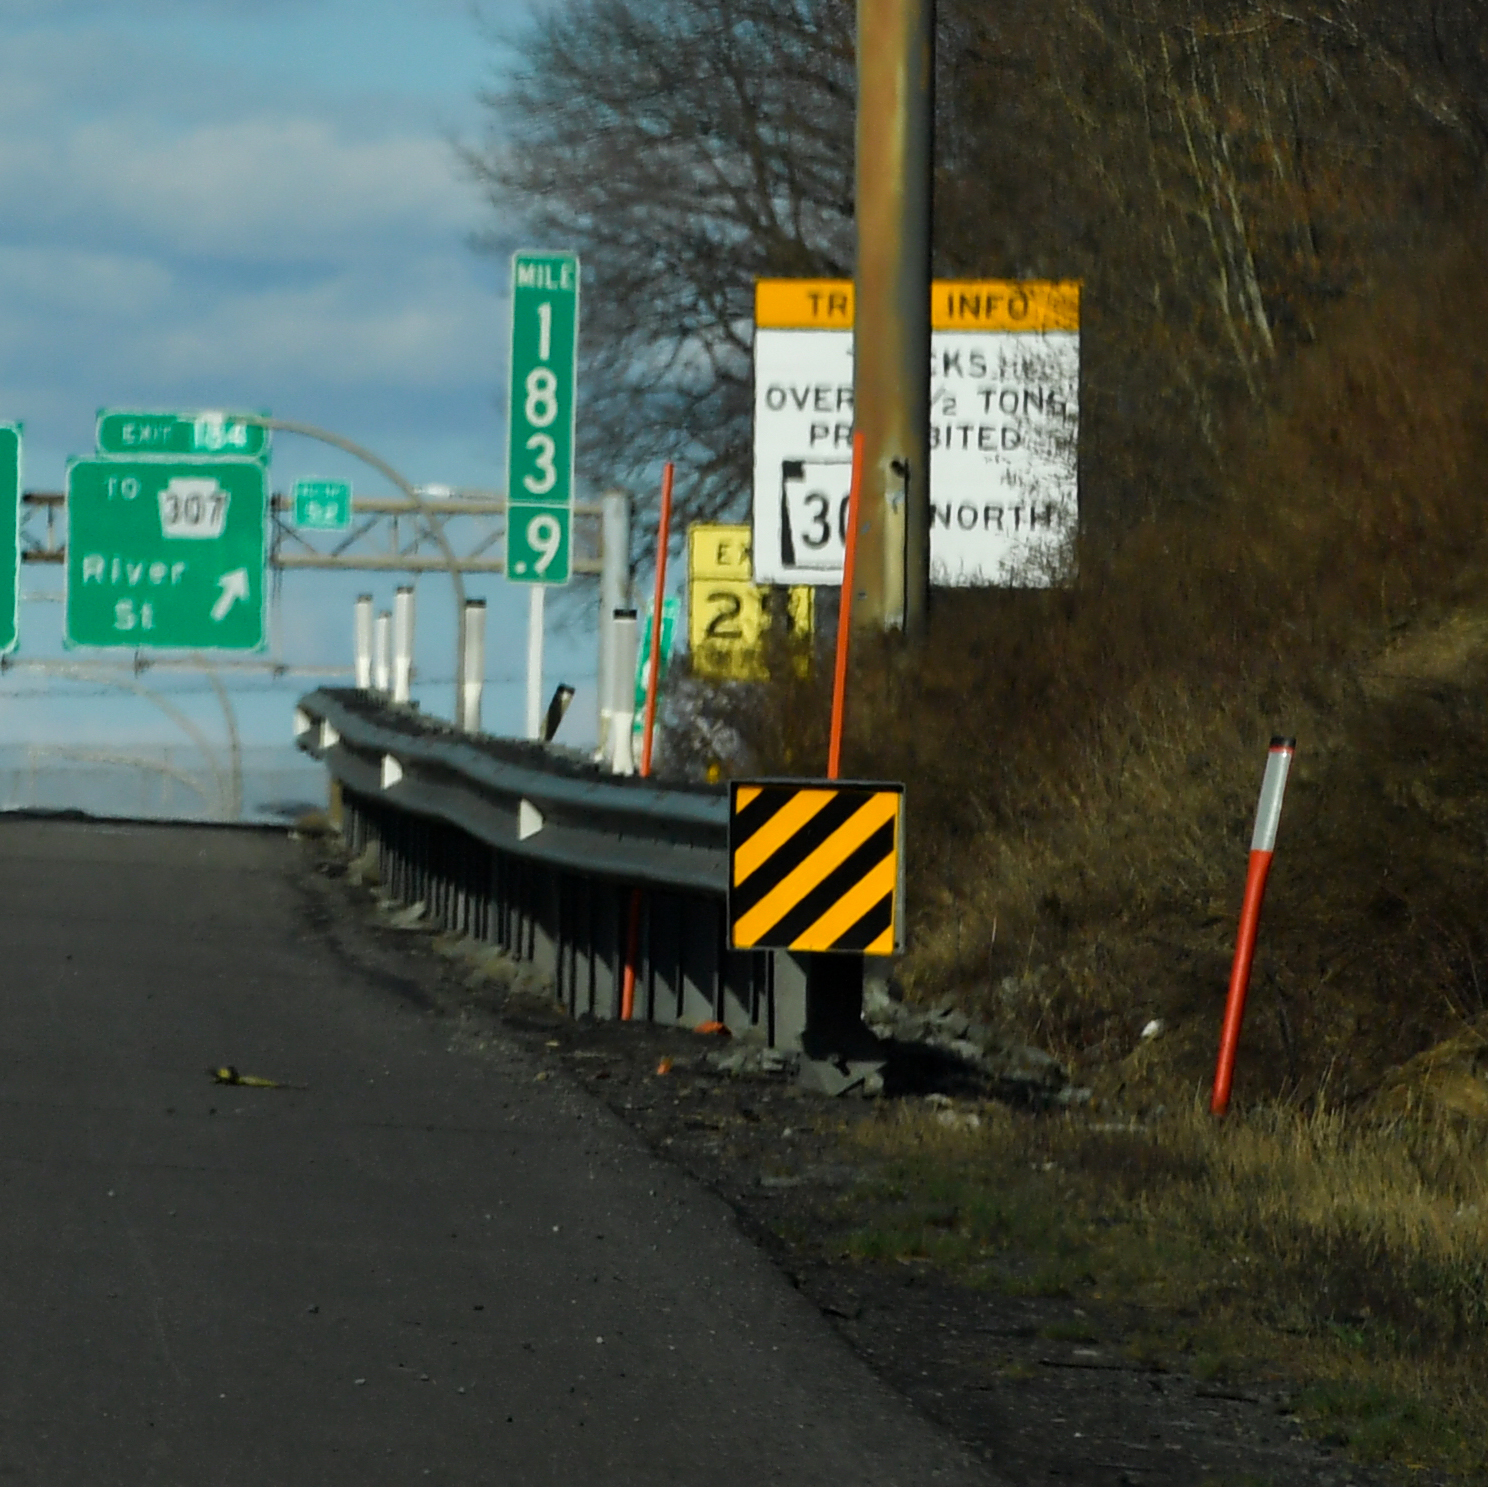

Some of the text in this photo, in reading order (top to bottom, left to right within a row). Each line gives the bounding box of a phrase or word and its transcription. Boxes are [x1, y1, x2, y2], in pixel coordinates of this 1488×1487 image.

[516, 263, 575, 291] MILE
[947, 291, 1029, 321] INFO
[121, 423, 172, 445] EXIT
[164, 491, 226, 527] 307
[82, 553, 187, 587] River
[112, 597, 155, 631] St
